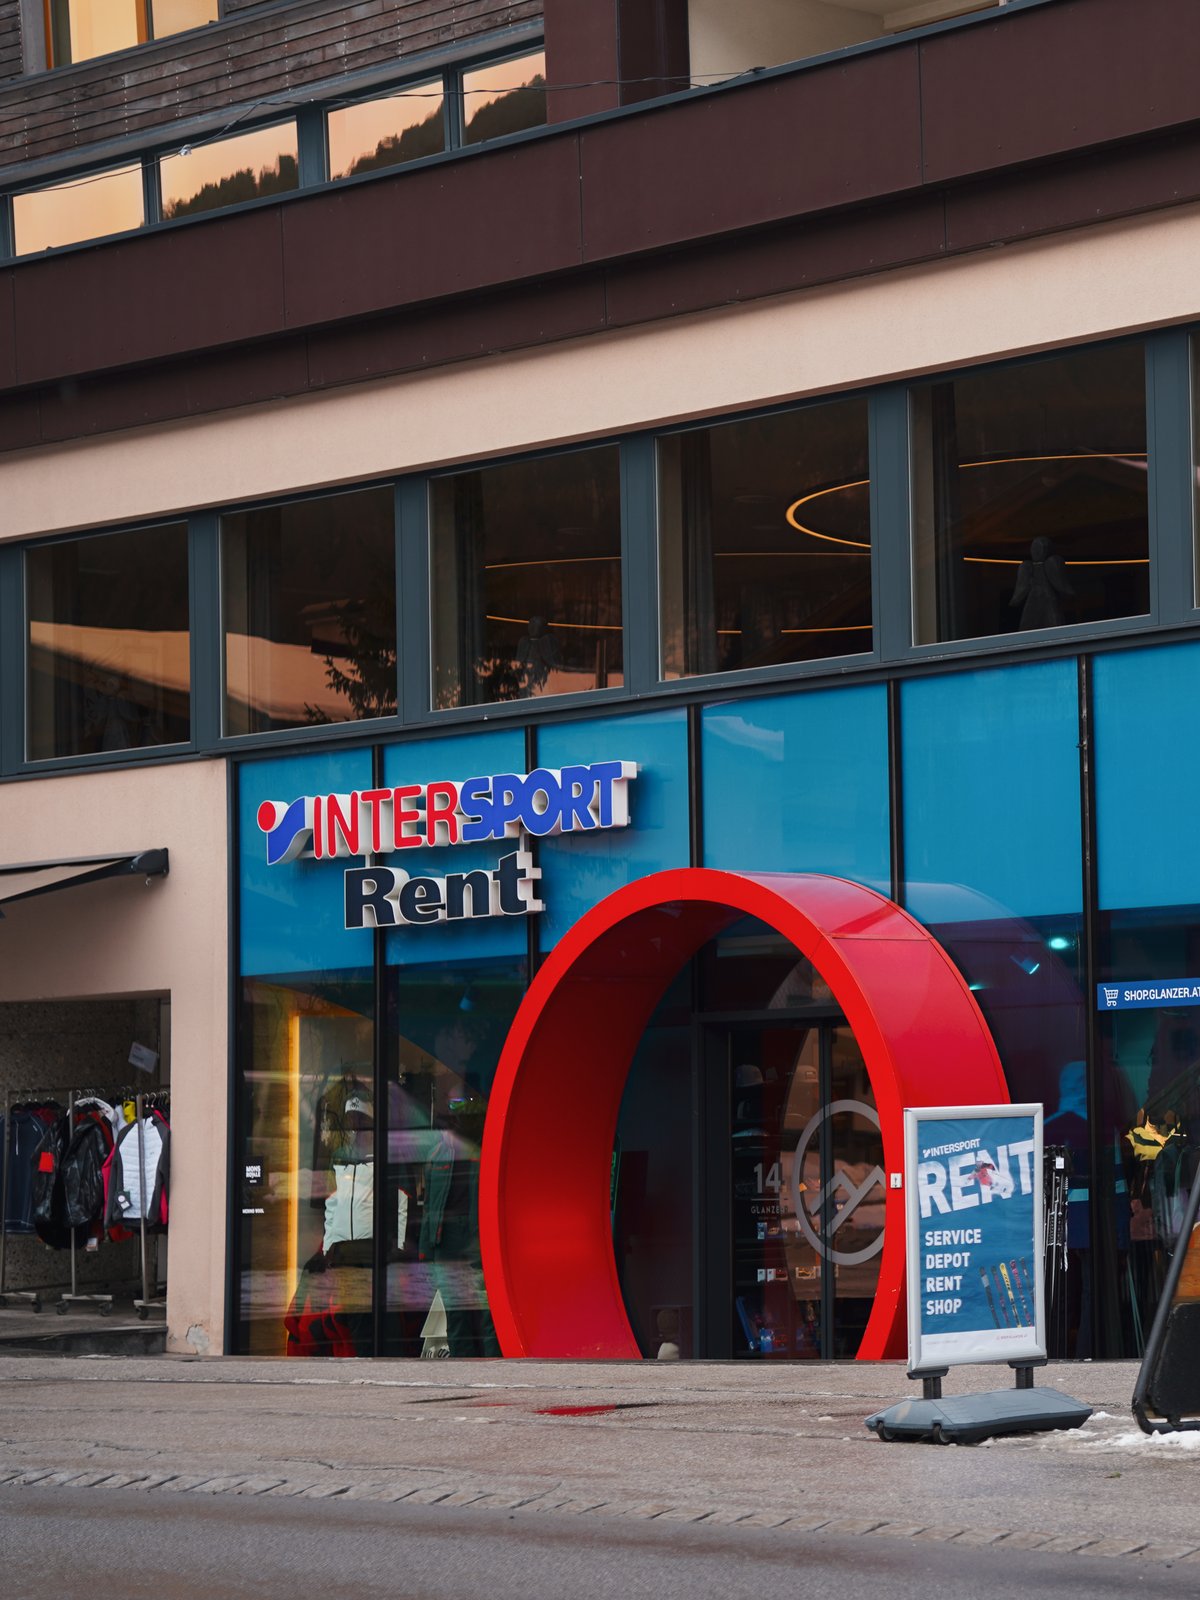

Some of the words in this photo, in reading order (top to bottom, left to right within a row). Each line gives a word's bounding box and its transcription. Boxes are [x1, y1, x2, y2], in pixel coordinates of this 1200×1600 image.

[313, 761, 628, 860] INTERSPORT
[344, 851, 531, 930] Rent
[931, 1138, 981, 1157] INTERSPORT
[753, 1162, 781, 1193] 14
[917, 1139, 1034, 1219] RENT
[925, 1228, 982, 1247] SERVICE
[926, 1252, 971, 1270] DEPOT
[926, 1275, 963, 1293] RENT
[926, 1298, 962, 1316] SHOP
